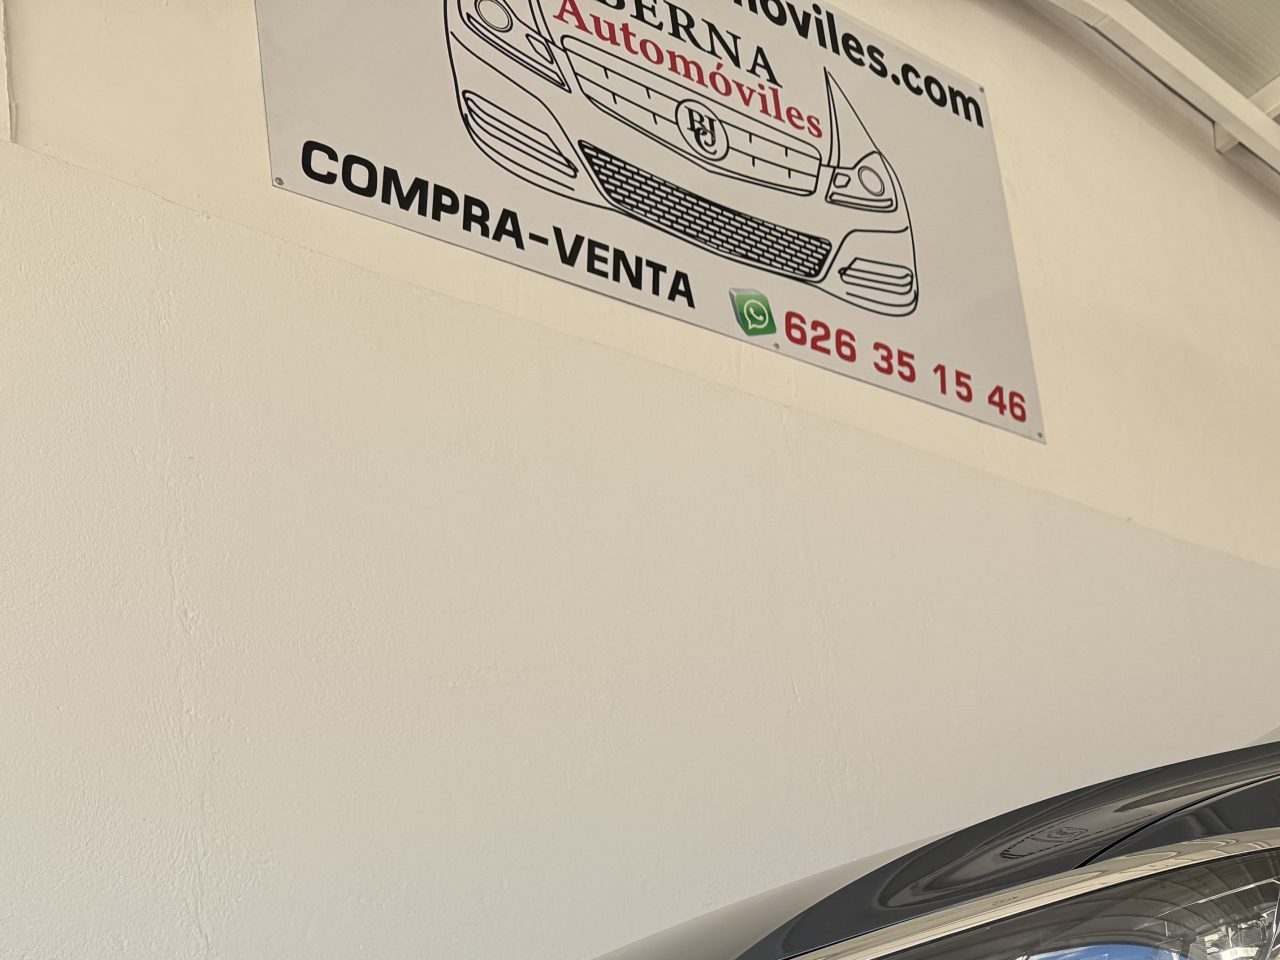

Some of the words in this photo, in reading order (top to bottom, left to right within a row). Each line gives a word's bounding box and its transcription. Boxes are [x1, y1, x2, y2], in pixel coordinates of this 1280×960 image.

[553, 0, 823, 138] Automóviles
[301, 140, 696, 309] COMPRA-VENTA
[784, 311, 857, 363] 626
[873, 341, 916, 383] 35
[933, 363, 973, 403] 15
[988, 385, 1027, 422] 46
